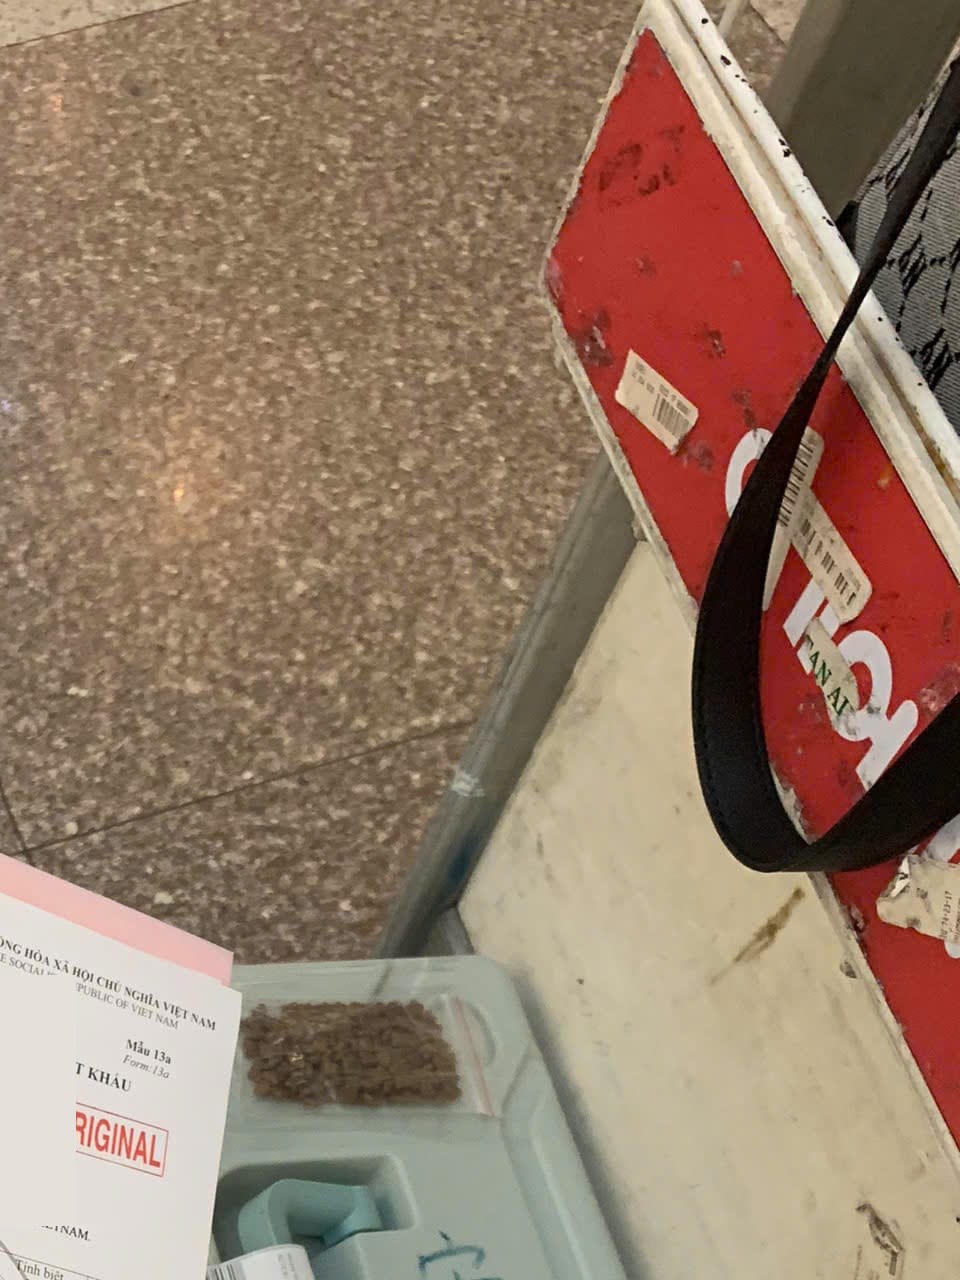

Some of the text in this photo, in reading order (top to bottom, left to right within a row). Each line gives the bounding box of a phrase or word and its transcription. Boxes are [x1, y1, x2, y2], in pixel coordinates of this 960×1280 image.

[72, 966, 94, 983] HỘI
[163, 1001, 189, 1020] VIỆT
[191, 1013, 216, 1031] NAM
[115, 998, 128, 1010] OF
[131, 1003, 153, 1020] VIET
[156, 1013, 178, 1030] NAM
[154, 1049, 171, 1064] 13a
[76, 1111, 161, 1168] RIGINAL
